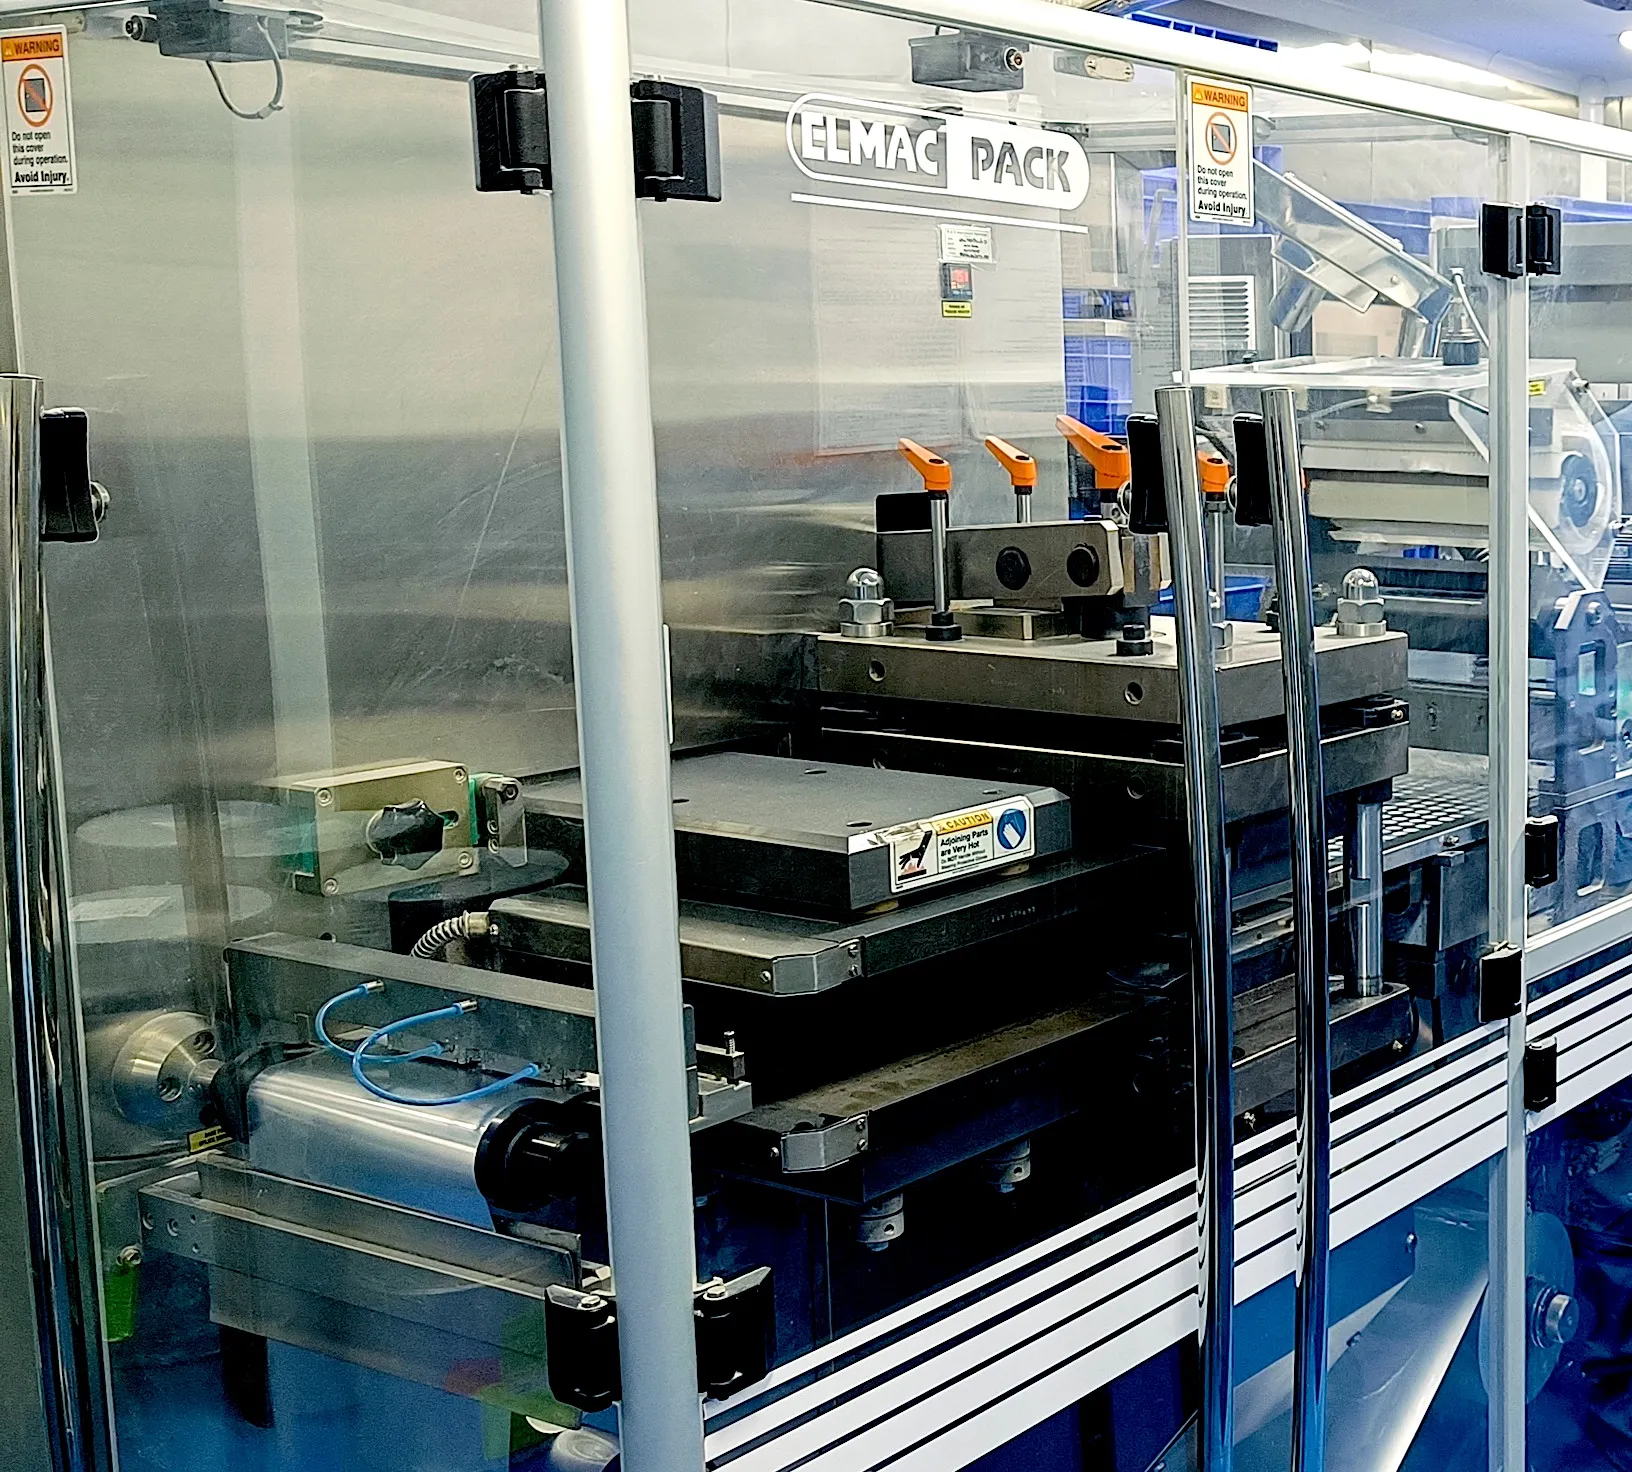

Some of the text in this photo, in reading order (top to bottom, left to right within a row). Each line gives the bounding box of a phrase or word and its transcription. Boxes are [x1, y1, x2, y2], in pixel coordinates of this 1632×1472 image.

[14, 39, 60, 55] WARNING
[1204, 90, 1246, 107] WARNING
[12, 131, 51, 142] Do not open
[12, 144, 44, 153] this cover
[13, 156, 34, 167] during
[971, 136, 1071, 193] PACK
[15, 170, 70, 184] Avoid Injury.
[1197, 164, 1234, 178] Do not open
[1197, 176, 1227, 187] this cover
[1197, 187, 1217, 198] during
[1198, 199, 1221, 212] Avoid
[946, 813, 990, 828] CAUTION
[940, 829, 989, 847] Adjoining Parts
[940, 848, 952, 857] are
[952, 845, 967, 854] Very
[968, 840, 980, 849] Hot
